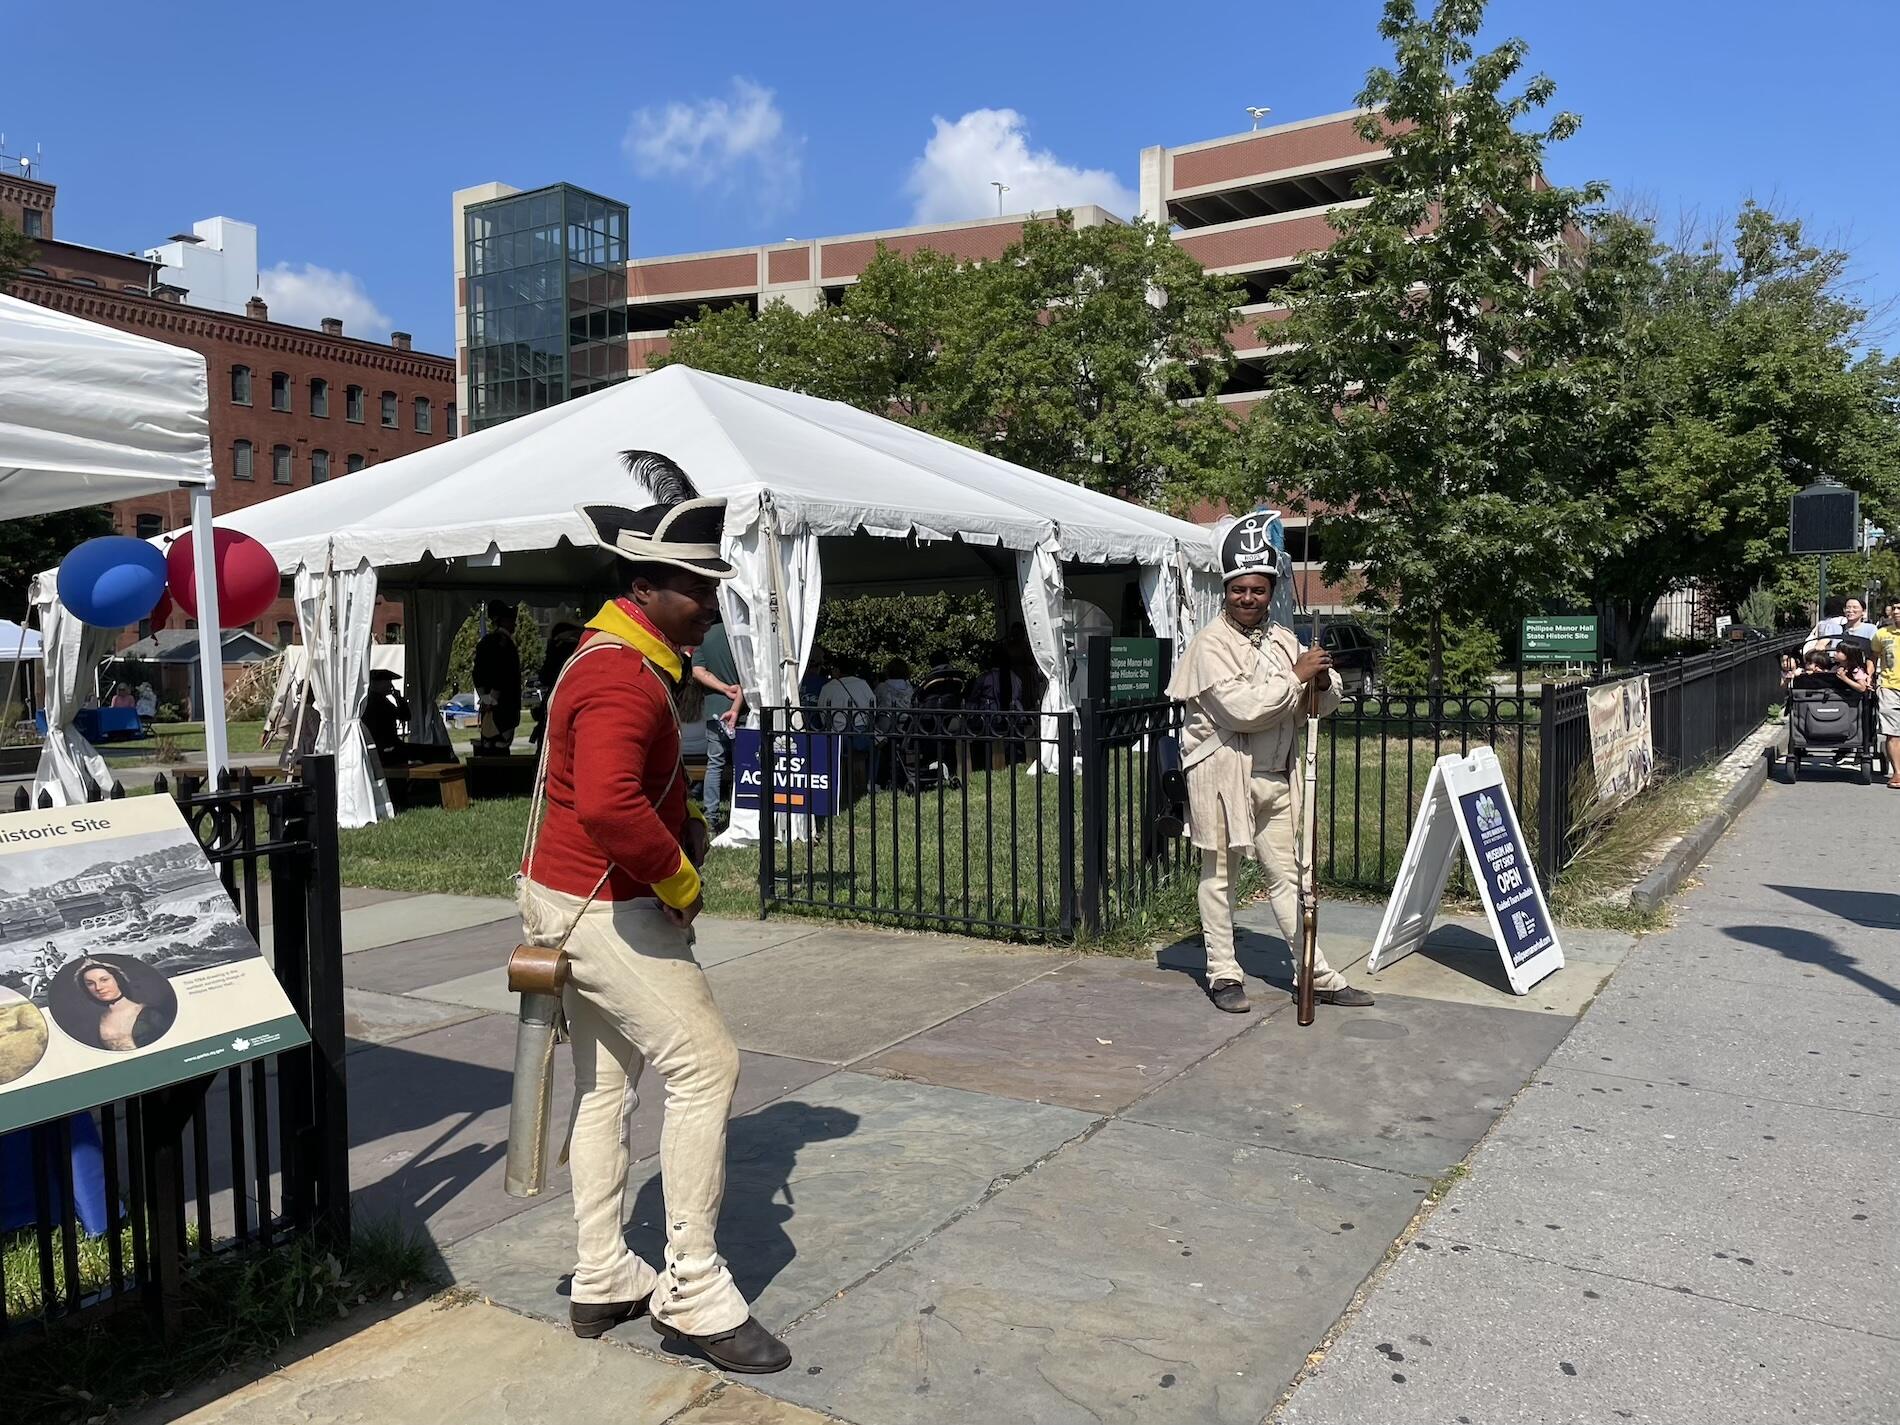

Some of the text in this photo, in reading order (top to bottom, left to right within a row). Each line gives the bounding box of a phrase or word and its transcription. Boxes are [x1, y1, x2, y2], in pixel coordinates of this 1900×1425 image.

[1526, 625, 1554, 633] Philipse
[1110, 658, 1153, 669] hilipse Manor Hall
[1120, 670, 1139, 679] Historic
[1139, 669, 1150, 678] Site
[740, 769, 829, 789] ACIVITIES
[0, 818, 111, 843] istoric Site
[1485, 842, 1515, 863] MUSEUM AND
[1492, 854, 1515, 873] GIFT SHOP
[1496, 866, 1523, 894] OPEN
